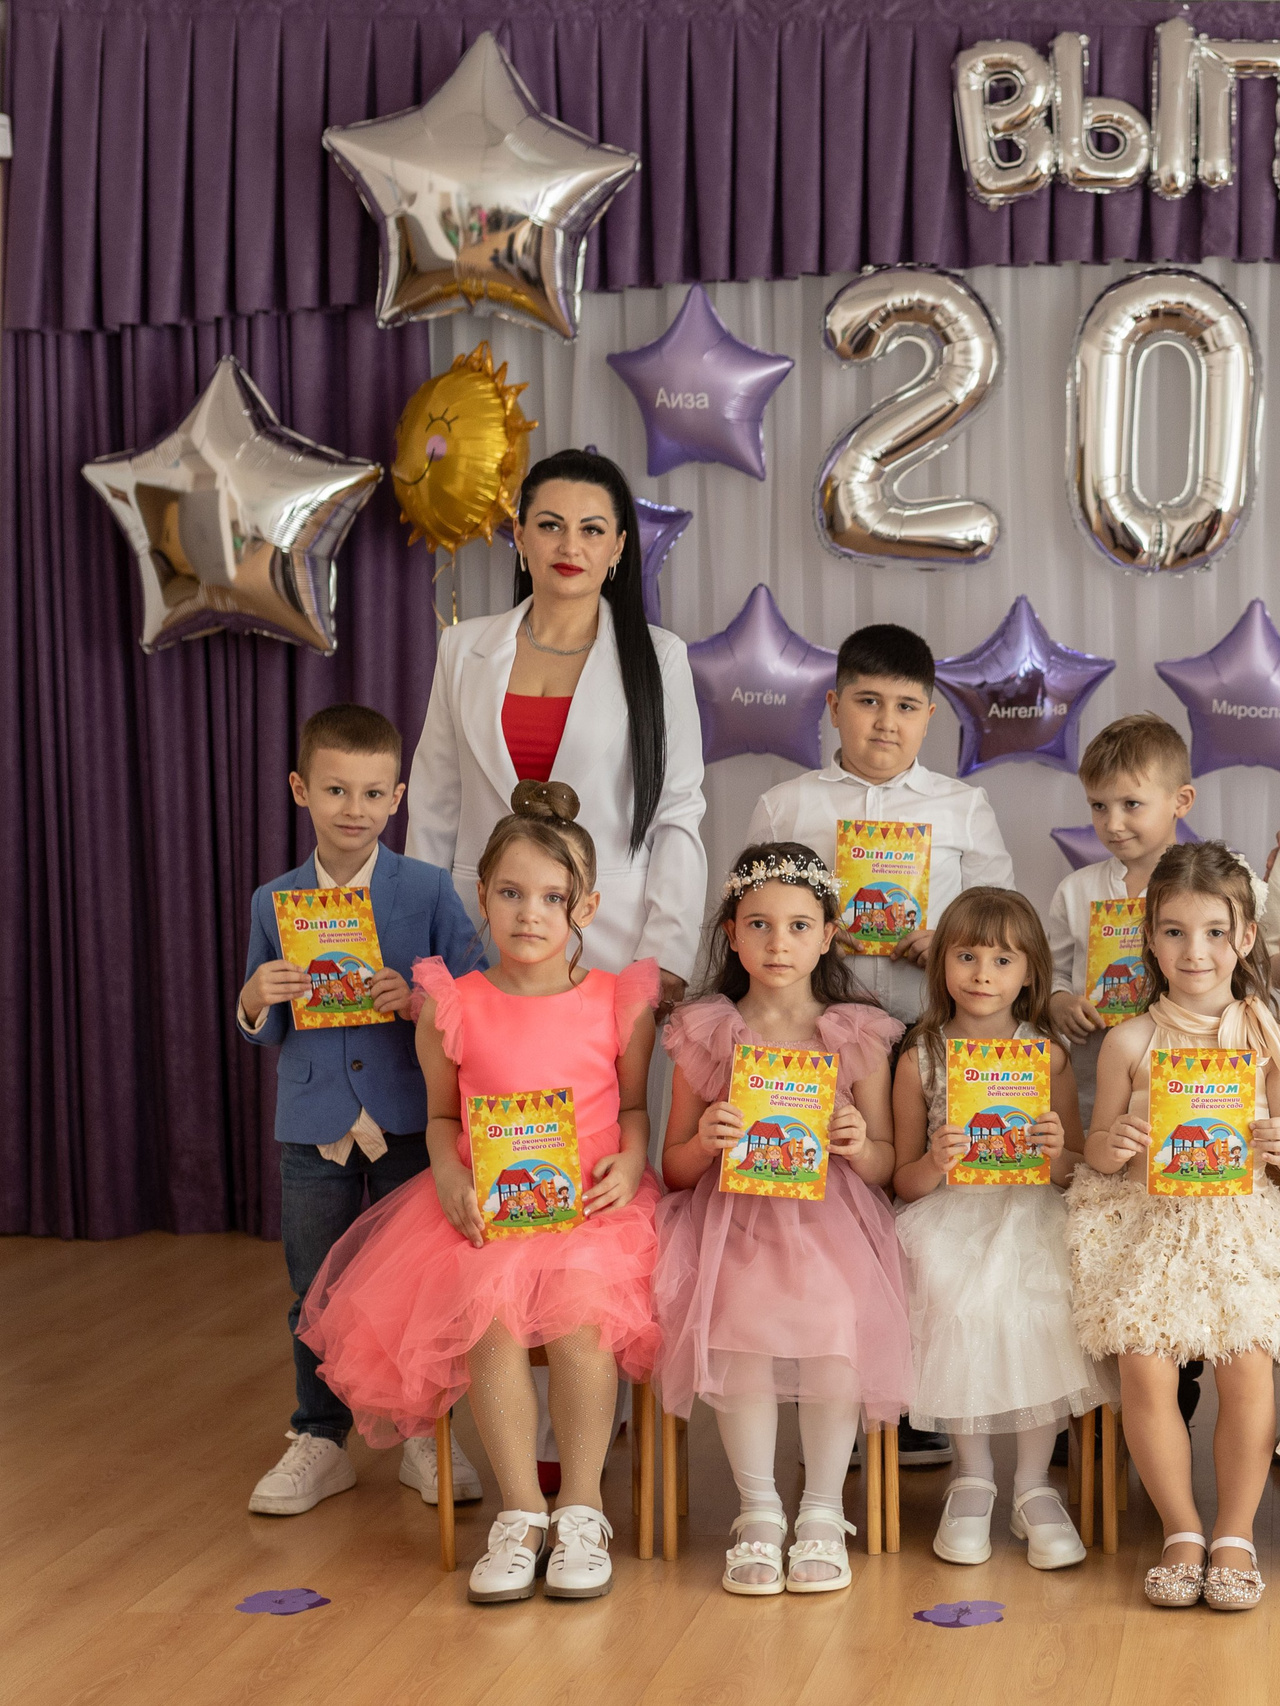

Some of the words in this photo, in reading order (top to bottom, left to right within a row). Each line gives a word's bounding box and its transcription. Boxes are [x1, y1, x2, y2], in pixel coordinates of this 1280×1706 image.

[655, 387, 709, 409] Аиза
[731, 686, 787, 707] Артём
[852, 847, 914, 861] Диплом
[294, 919, 359, 931] Диплом
[1103, 926, 1143, 937] Дипл
[965, 1069, 1033, 1081] Диплом
[749, 1076, 818, 1094] Диплом
[1168, 1081, 1238, 1094] Диплом
[488, 1123, 557, 1138] Диплом
